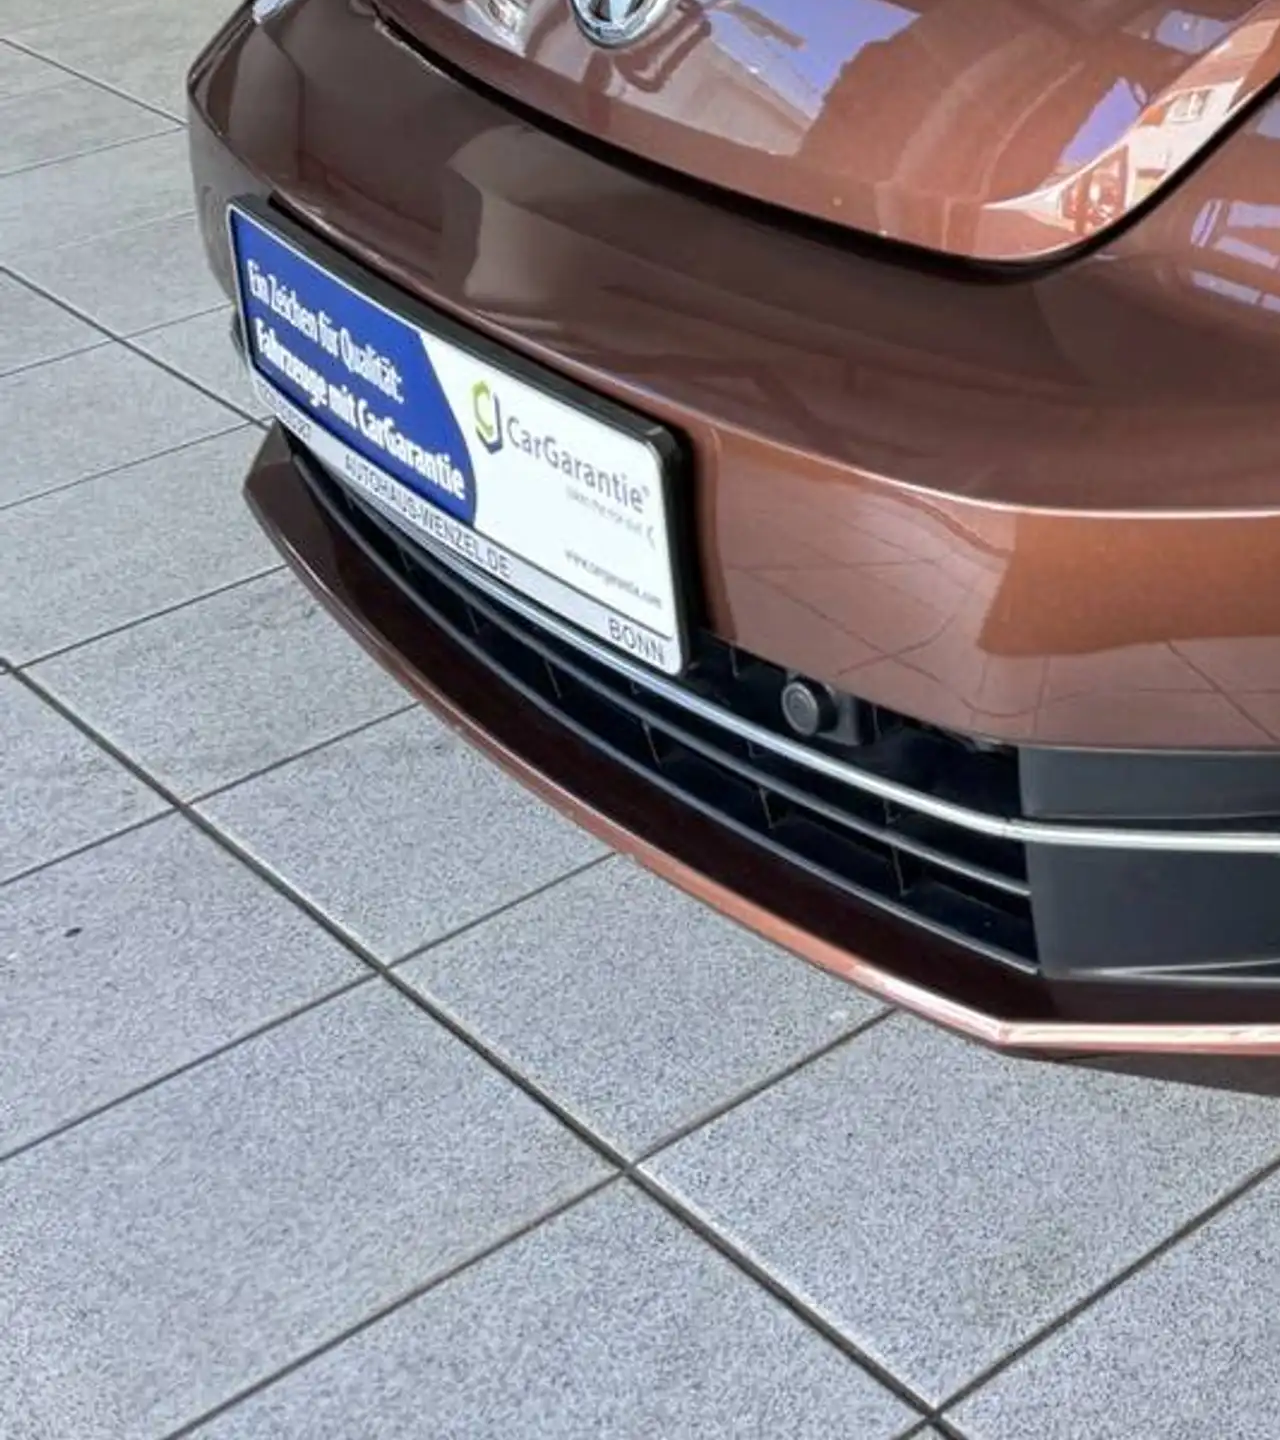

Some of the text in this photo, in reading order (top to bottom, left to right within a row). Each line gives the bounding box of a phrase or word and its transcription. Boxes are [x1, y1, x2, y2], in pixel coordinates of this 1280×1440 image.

[268, 273, 318, 342] Zeichen
[318, 310, 339, 357] für
[255, 317, 328, 408] Fahrzeuge
[328, 383, 357, 430] mit
[357, 398, 466, 500] CarGarantie
[607, 617, 666, 665] BONN
